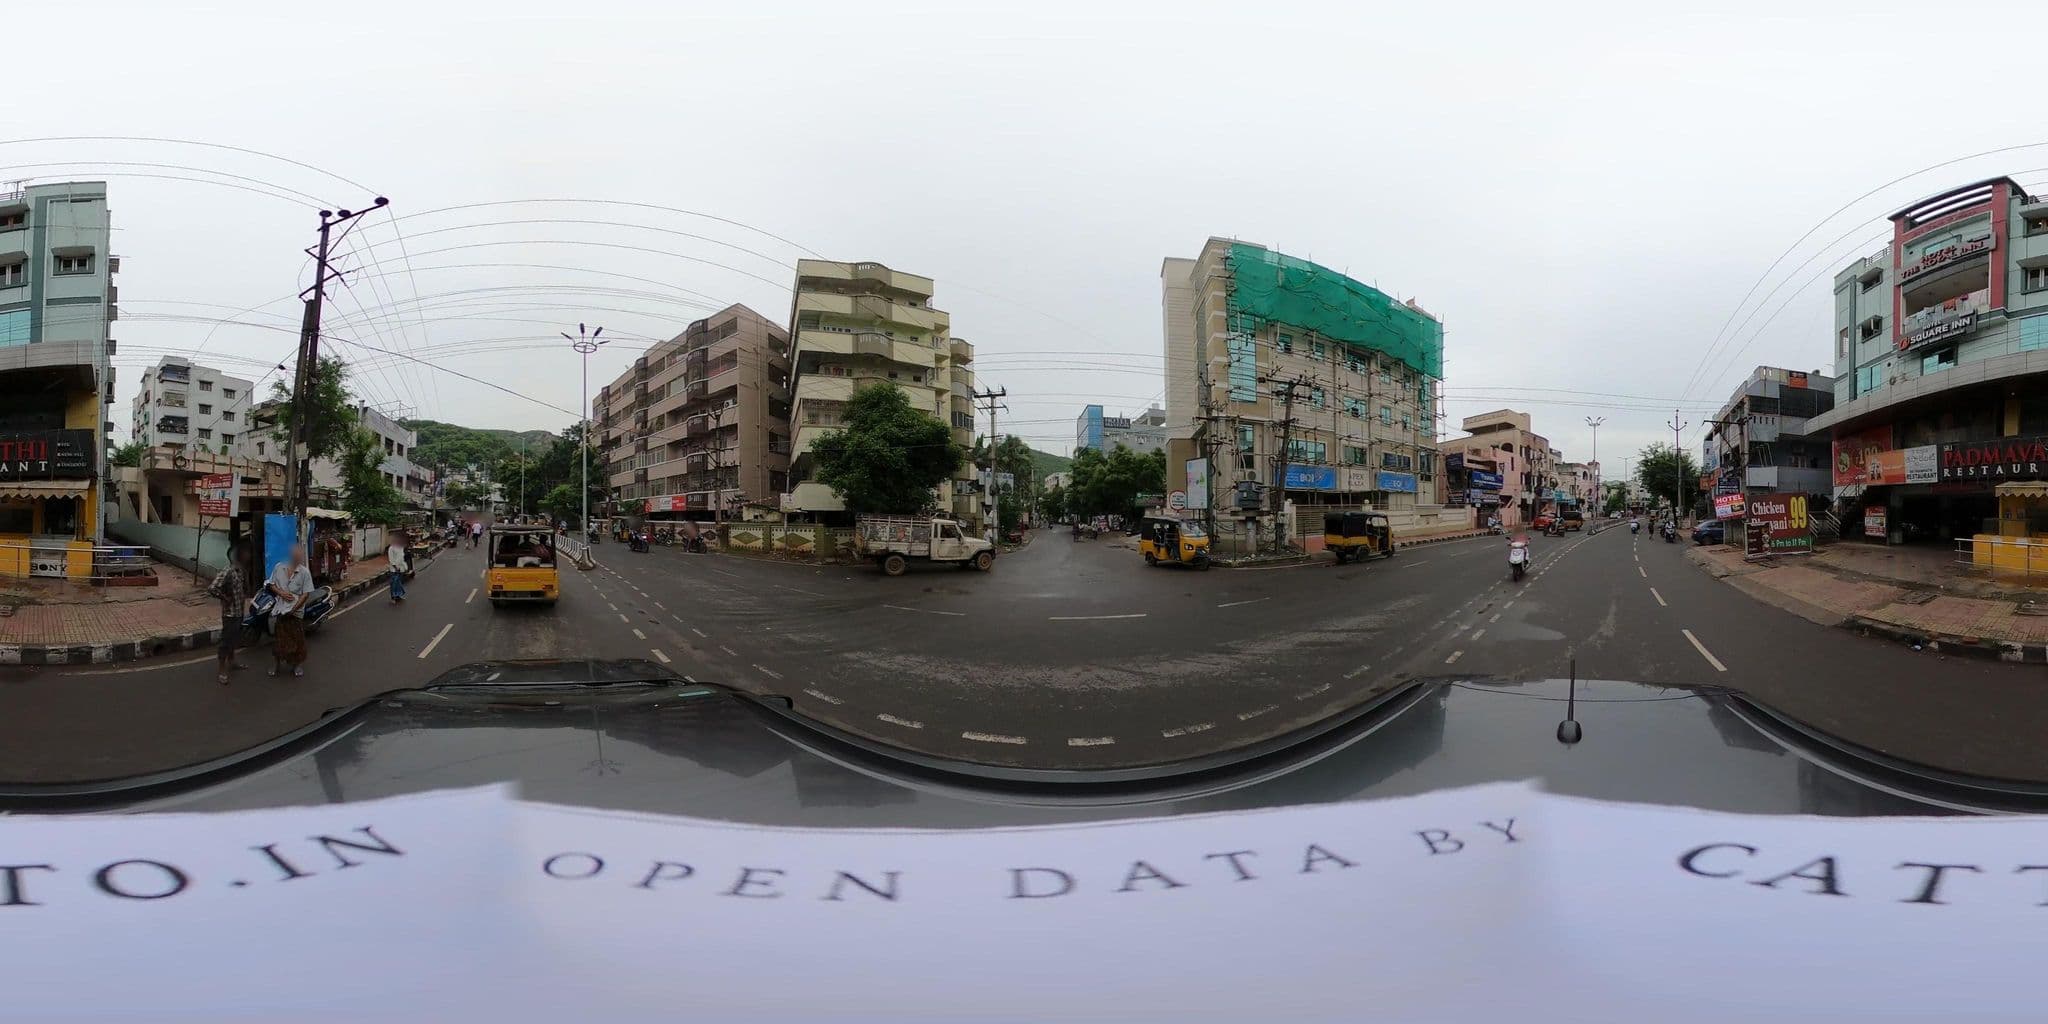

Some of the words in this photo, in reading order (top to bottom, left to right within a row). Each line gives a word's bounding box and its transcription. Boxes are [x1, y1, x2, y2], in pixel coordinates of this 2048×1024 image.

[1910, 323, 1949, 344] SQUARE
[1951, 317, 1970, 330] INN
[0, 461, 48, 472] ANT
[1943, 463, 2038, 477] RESTAUR
[1716, 494, 1743, 504] HOTEL
[1752, 502, 1786, 515] Chicken
[1790, 496, 1807, 529] 99
[543, 851, 902, 901] OPEN
[1007, 843, 1360, 899] DATA
[1415, 818, 1524, 855] BY
[1678, 842, 2048, 906] CAT
